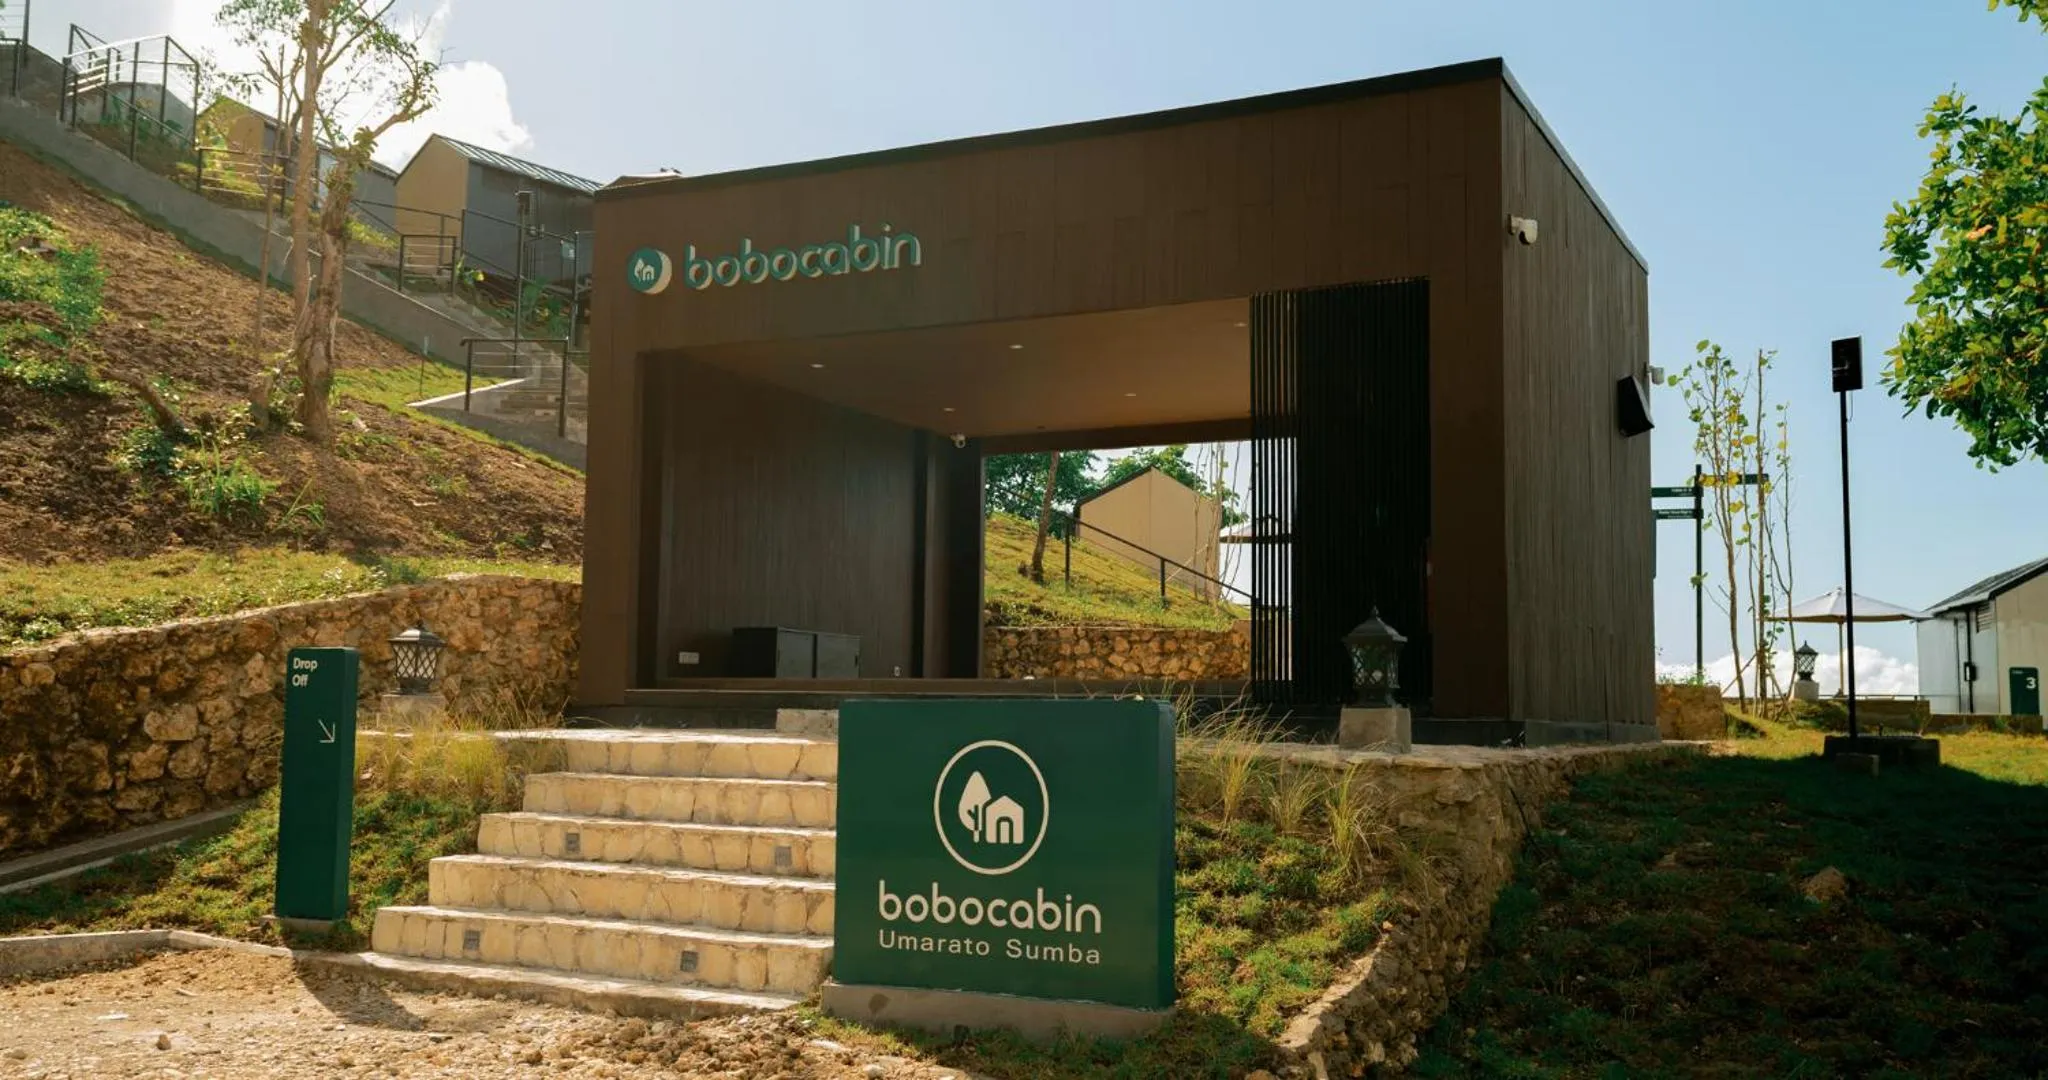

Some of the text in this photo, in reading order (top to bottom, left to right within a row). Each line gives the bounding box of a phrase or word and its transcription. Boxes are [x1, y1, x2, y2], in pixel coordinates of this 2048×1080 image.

[684, 223, 922, 290] bobocabin
[292, 657, 318, 672] Drop
[292, 674, 309, 687] Off
[2025, 676, 2037, 690] 3
[878, 879, 1102, 934] bobocabin
[878, 928, 1101, 965] Umarato Sumba
